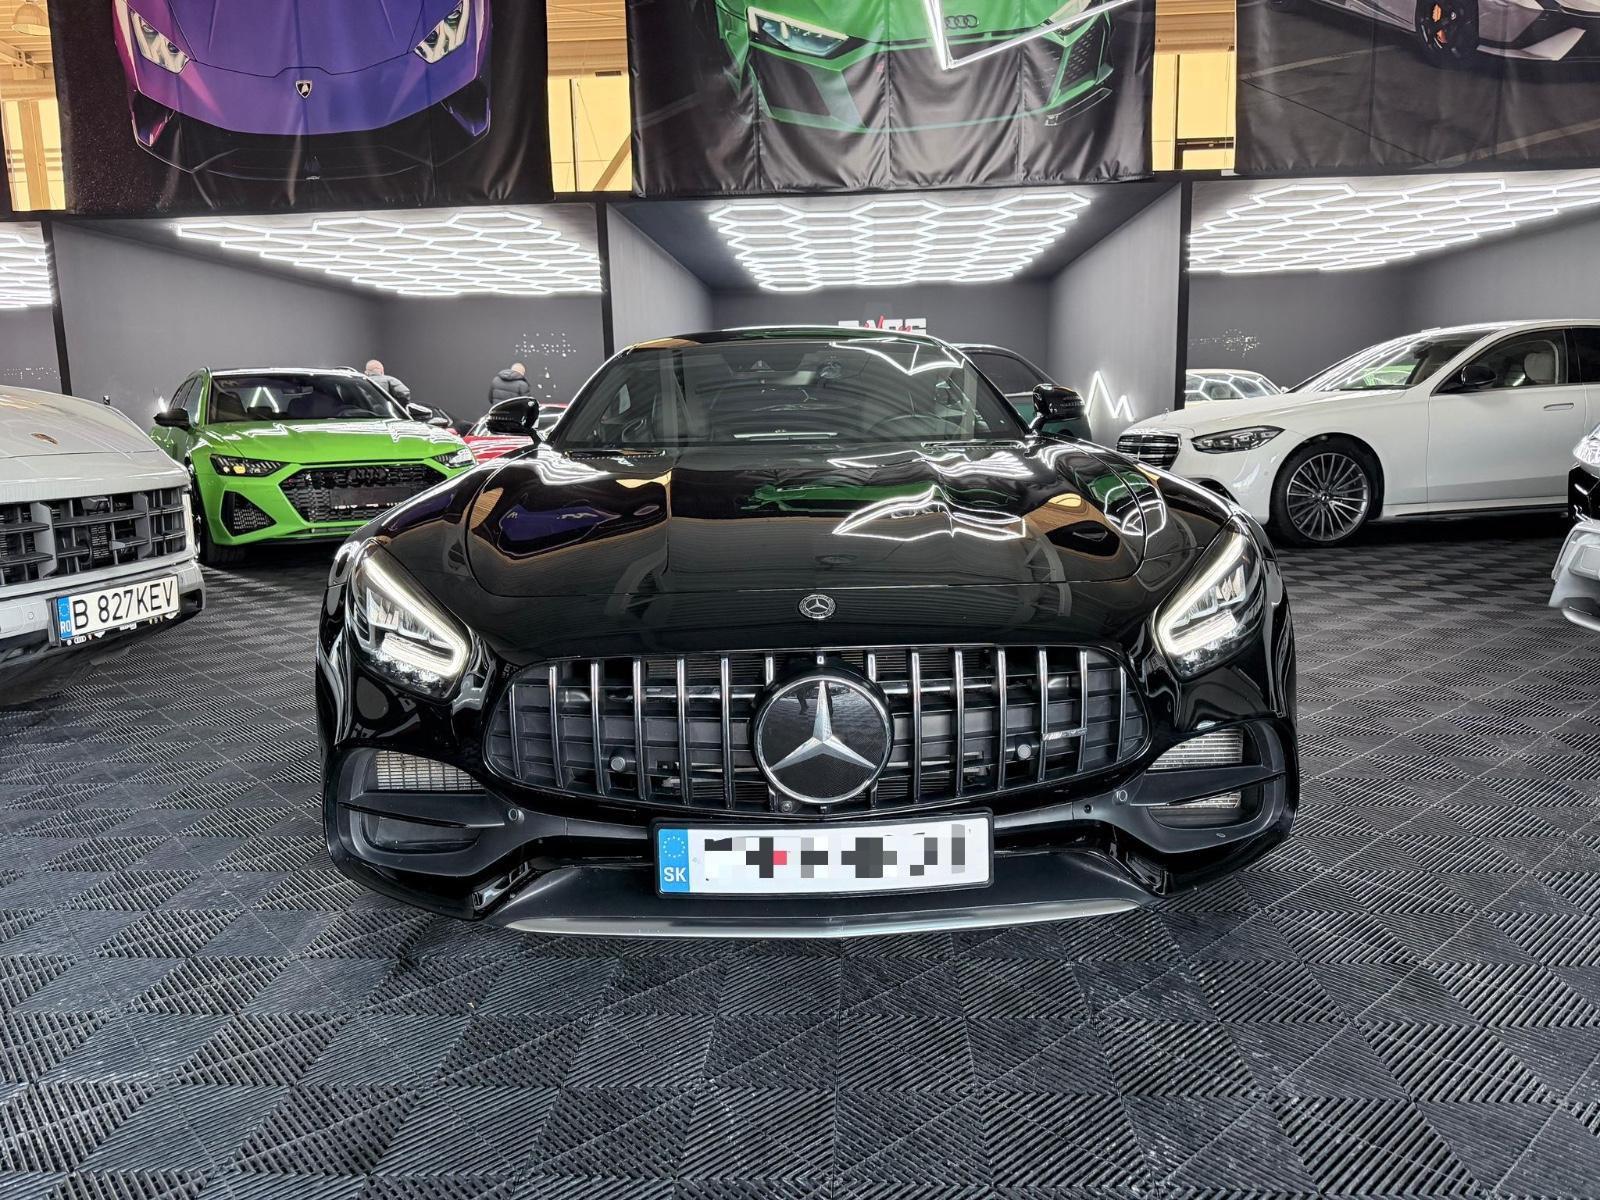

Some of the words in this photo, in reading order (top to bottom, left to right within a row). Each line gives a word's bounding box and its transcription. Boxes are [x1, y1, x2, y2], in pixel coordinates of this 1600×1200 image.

[72, 599, 89, 630] B
[60, 620, 72, 633] RO
[663, 866, 687, 882] SK
